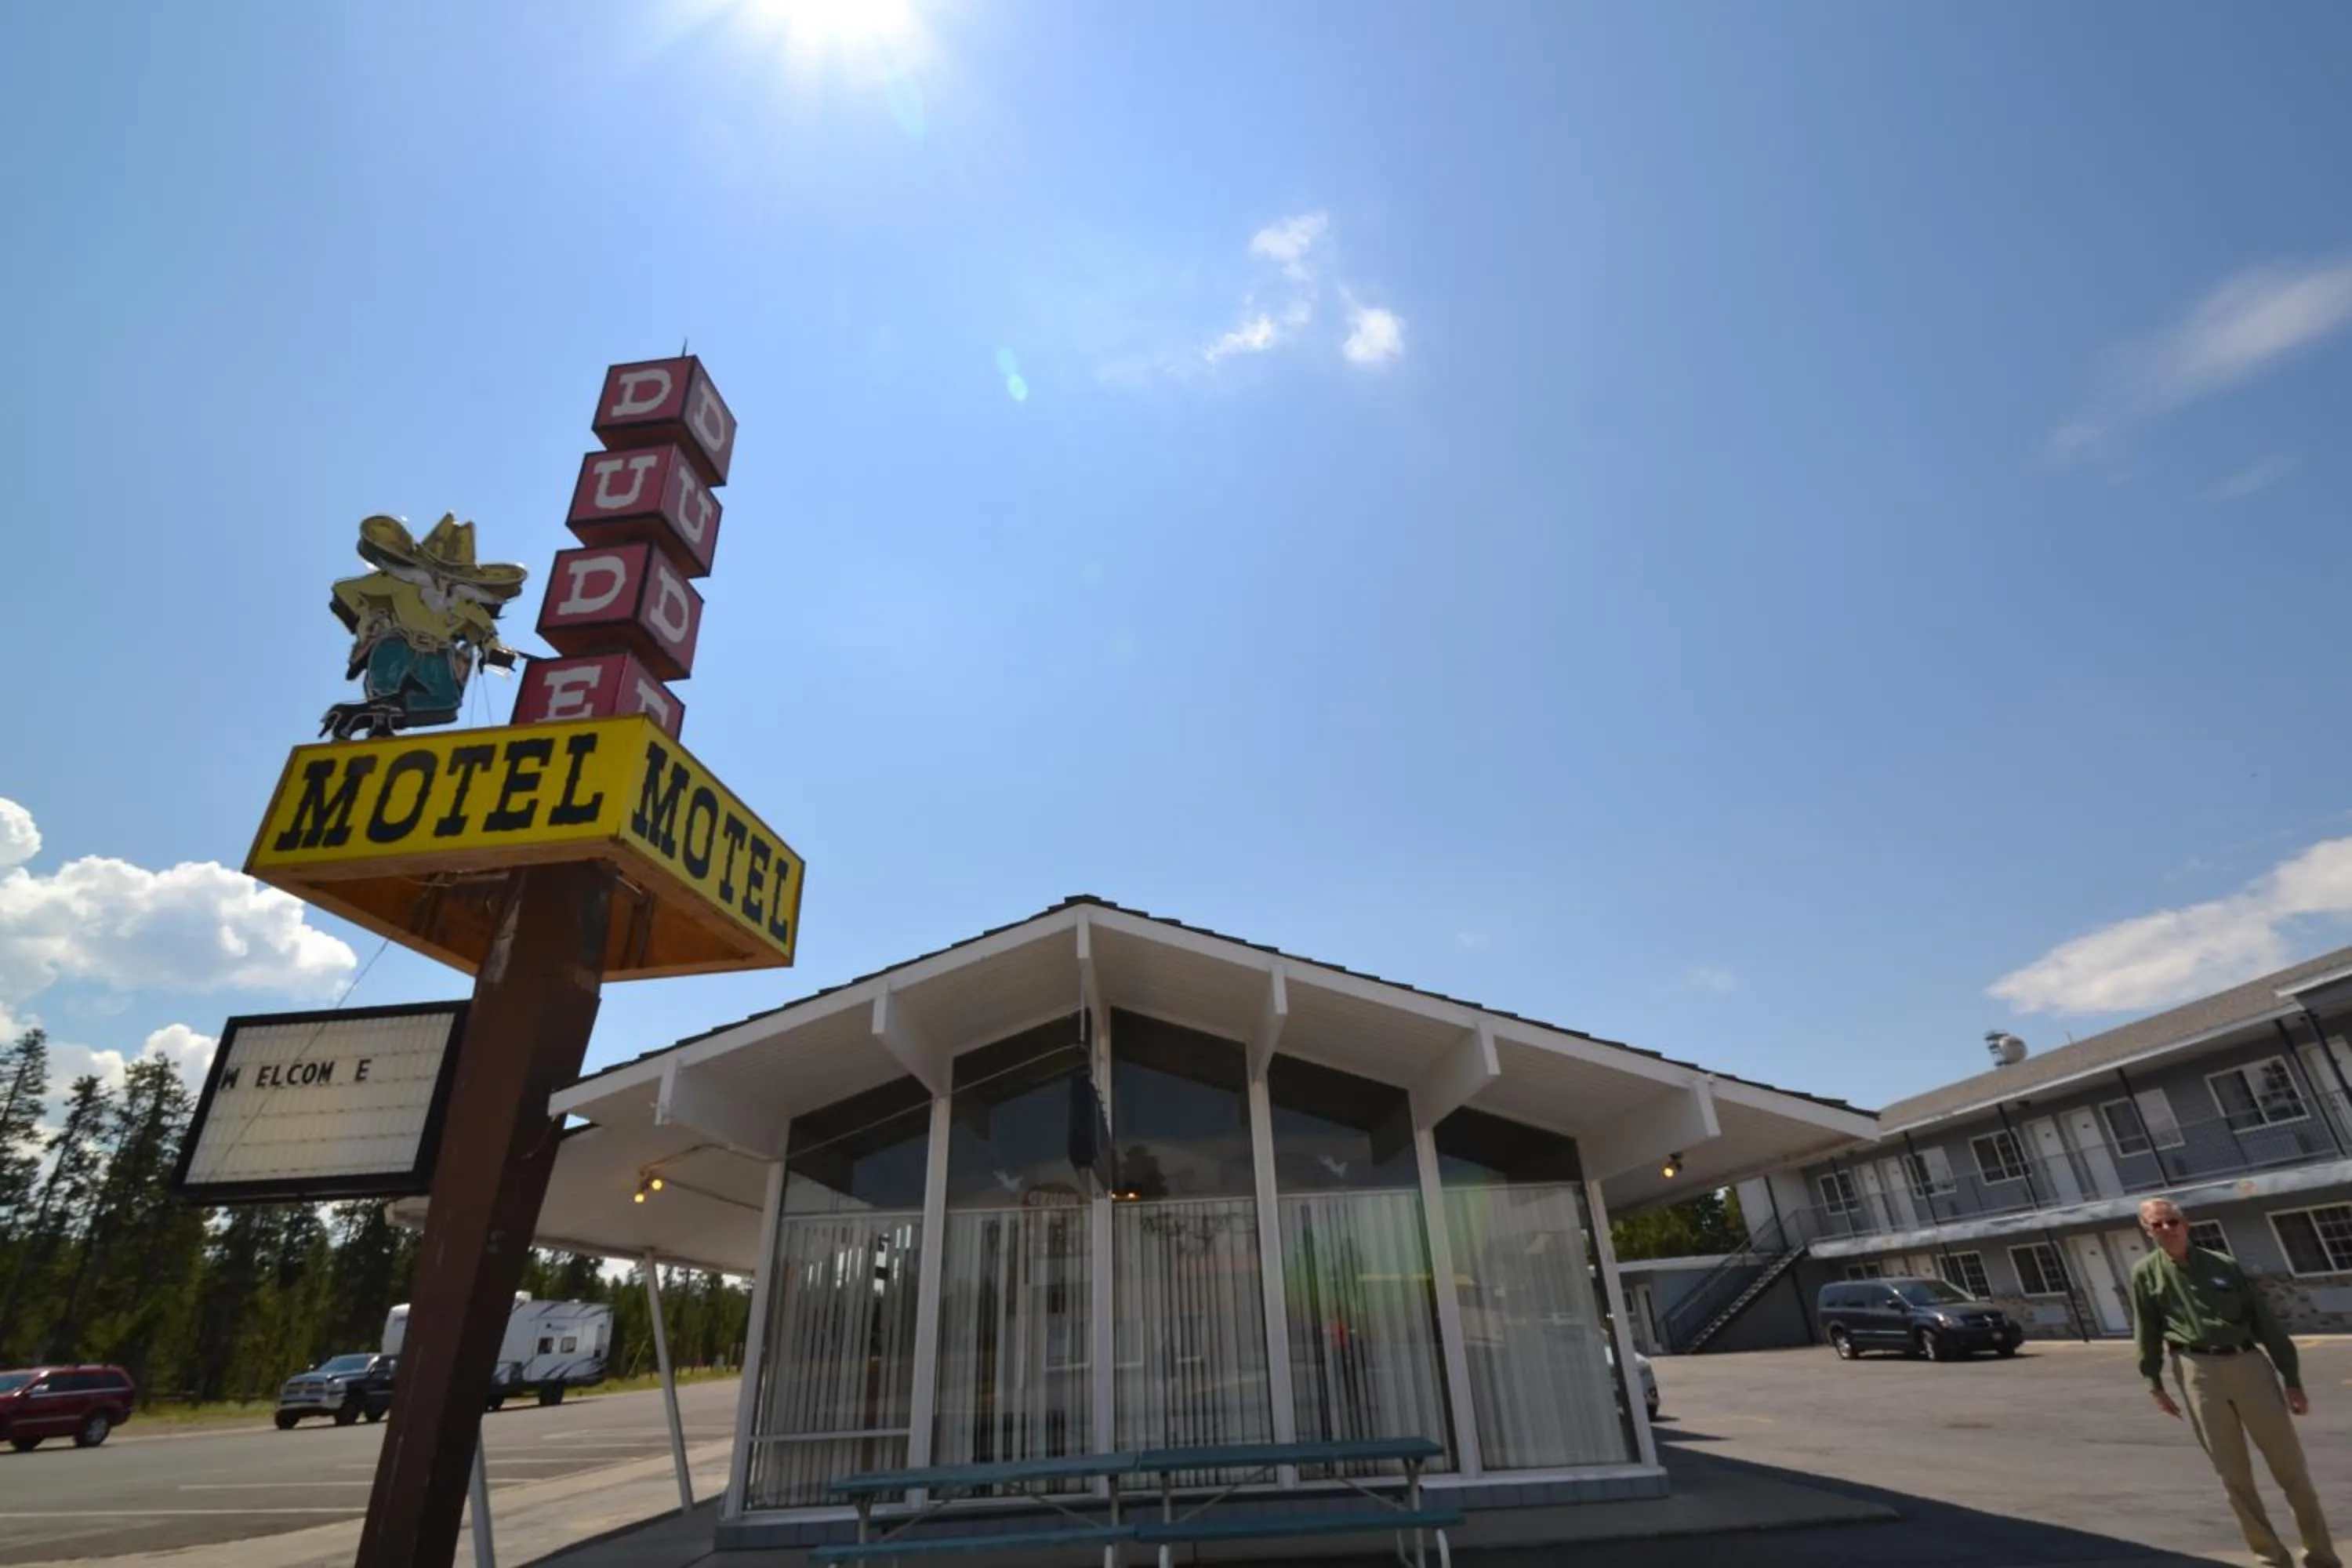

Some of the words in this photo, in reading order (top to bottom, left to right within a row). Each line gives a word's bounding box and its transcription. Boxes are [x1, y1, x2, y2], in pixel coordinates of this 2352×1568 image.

[535, 368, 673, 723] DUDE
[274, 733, 604, 852] MOTEL
[630, 741, 789, 945] MOTEL
